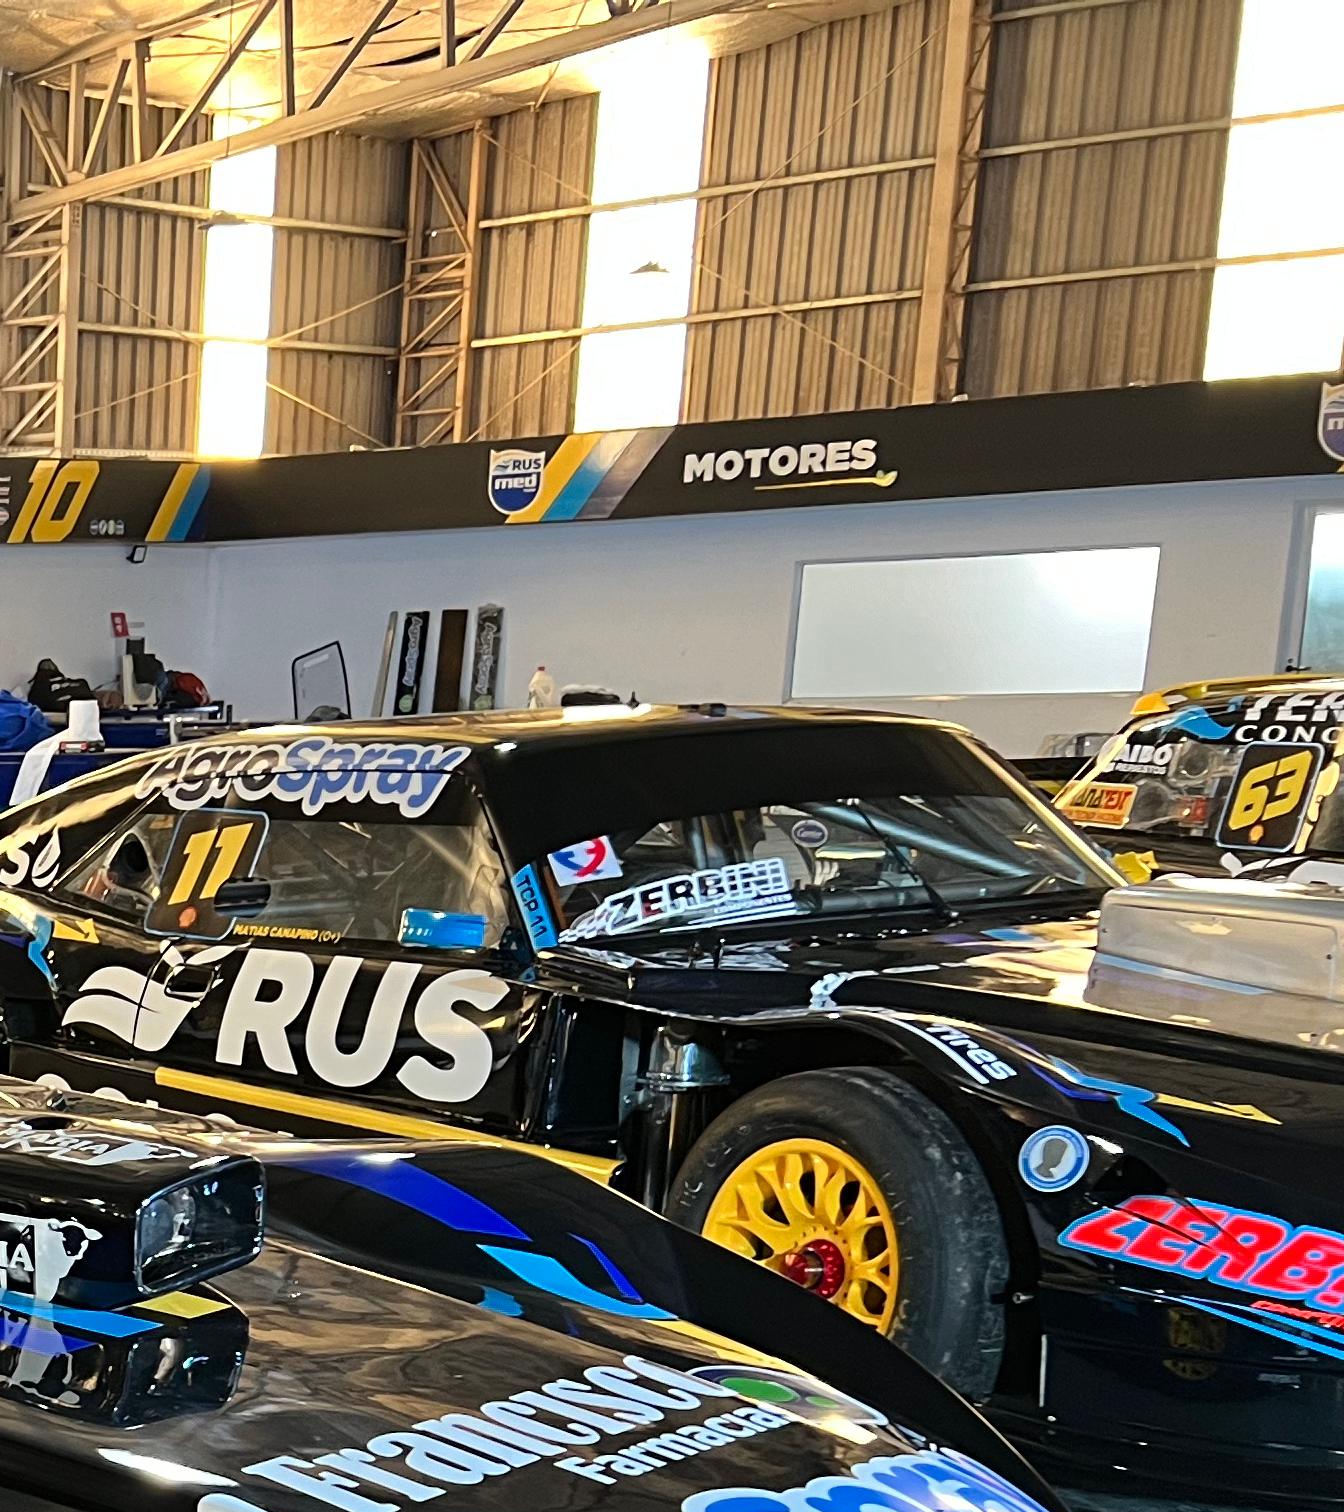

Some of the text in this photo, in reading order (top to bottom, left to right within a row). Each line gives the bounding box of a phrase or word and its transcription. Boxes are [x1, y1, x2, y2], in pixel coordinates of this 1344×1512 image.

[494, 473, 538, 490] med
[512, 458, 542, 471] RUS
[683, 438, 879, 484] MOTORES
[6, 460, 100, 544] 10
[136, 737, 472, 818] AgroSpray
[1118, 743, 1174, 766] AIBO
[1227, 750, 1313, 831] 63
[167, 822, 254, 906] 11
[608, 857, 790, 936] ZERBINI
[516, 874, 548, 940] TCP 11
[215, 947, 515, 1104] RUS
[925, 1022, 1018, 1081] Tires
[1057, 1194, 1344, 1314] ZERB
